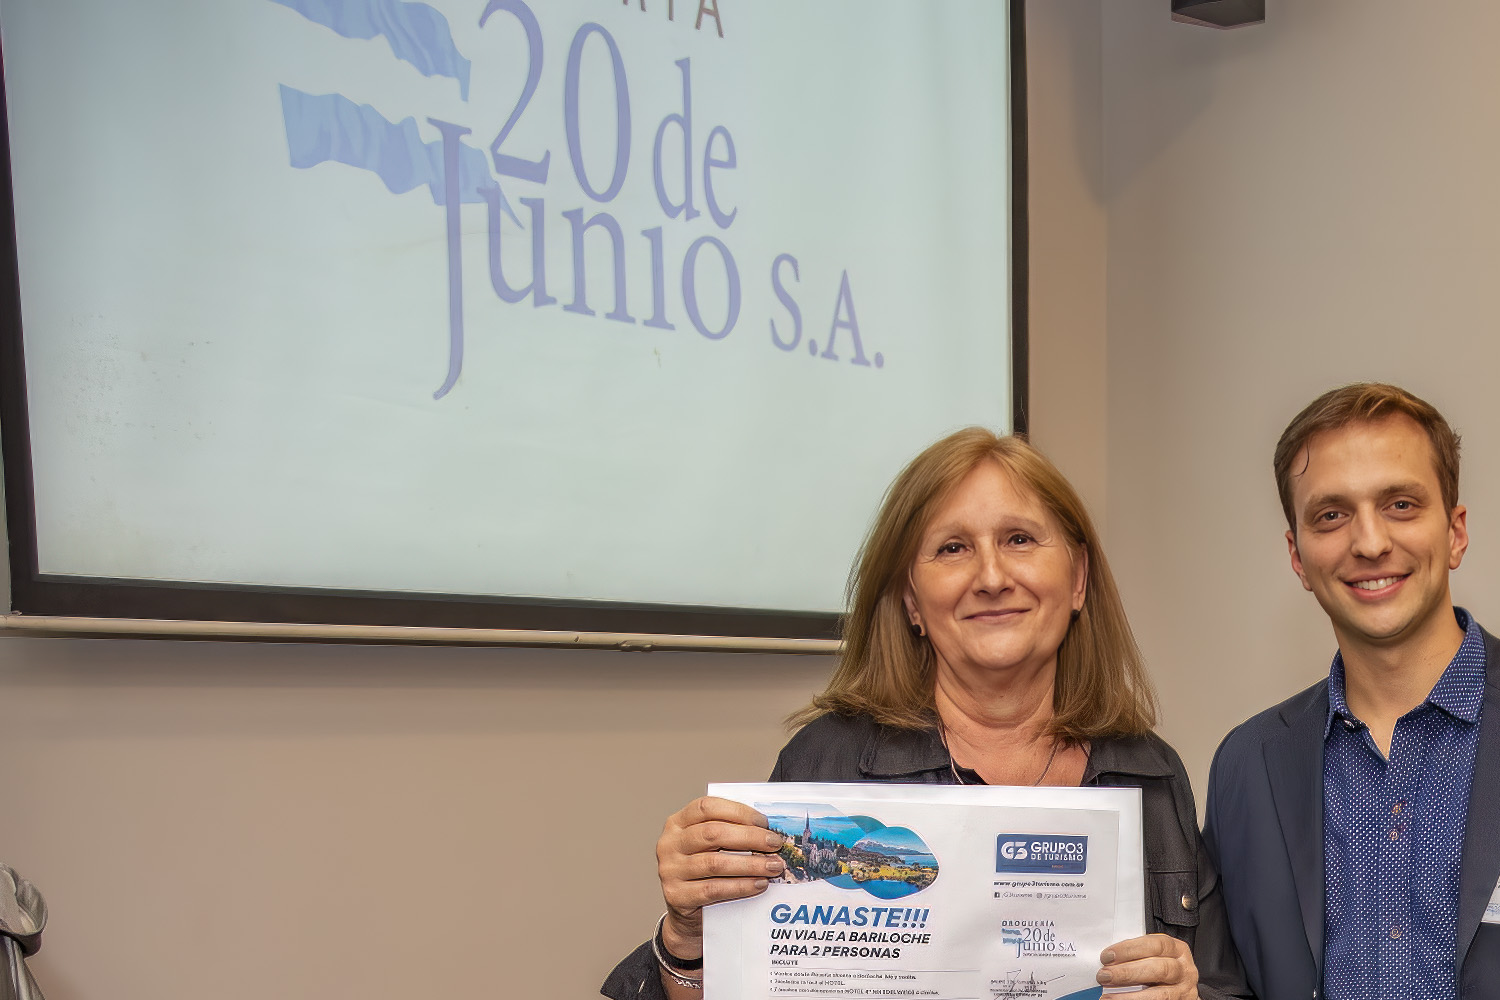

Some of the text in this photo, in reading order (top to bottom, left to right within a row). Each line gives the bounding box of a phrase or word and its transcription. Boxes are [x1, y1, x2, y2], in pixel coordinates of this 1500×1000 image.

[478, 0, 738, 229] 20 de
[425, 116, 885, 400] Junio S.A.
[1030, 853, 1084, 862] DE TURISMO
[770, 903, 930, 929] GANASTE!!!
[771, 928, 931, 944] UN VIAJE A BARILOCHE
[1023, 927, 1055, 942] 20 de
[770, 944, 901, 959] PARA 2 PERSONAS
